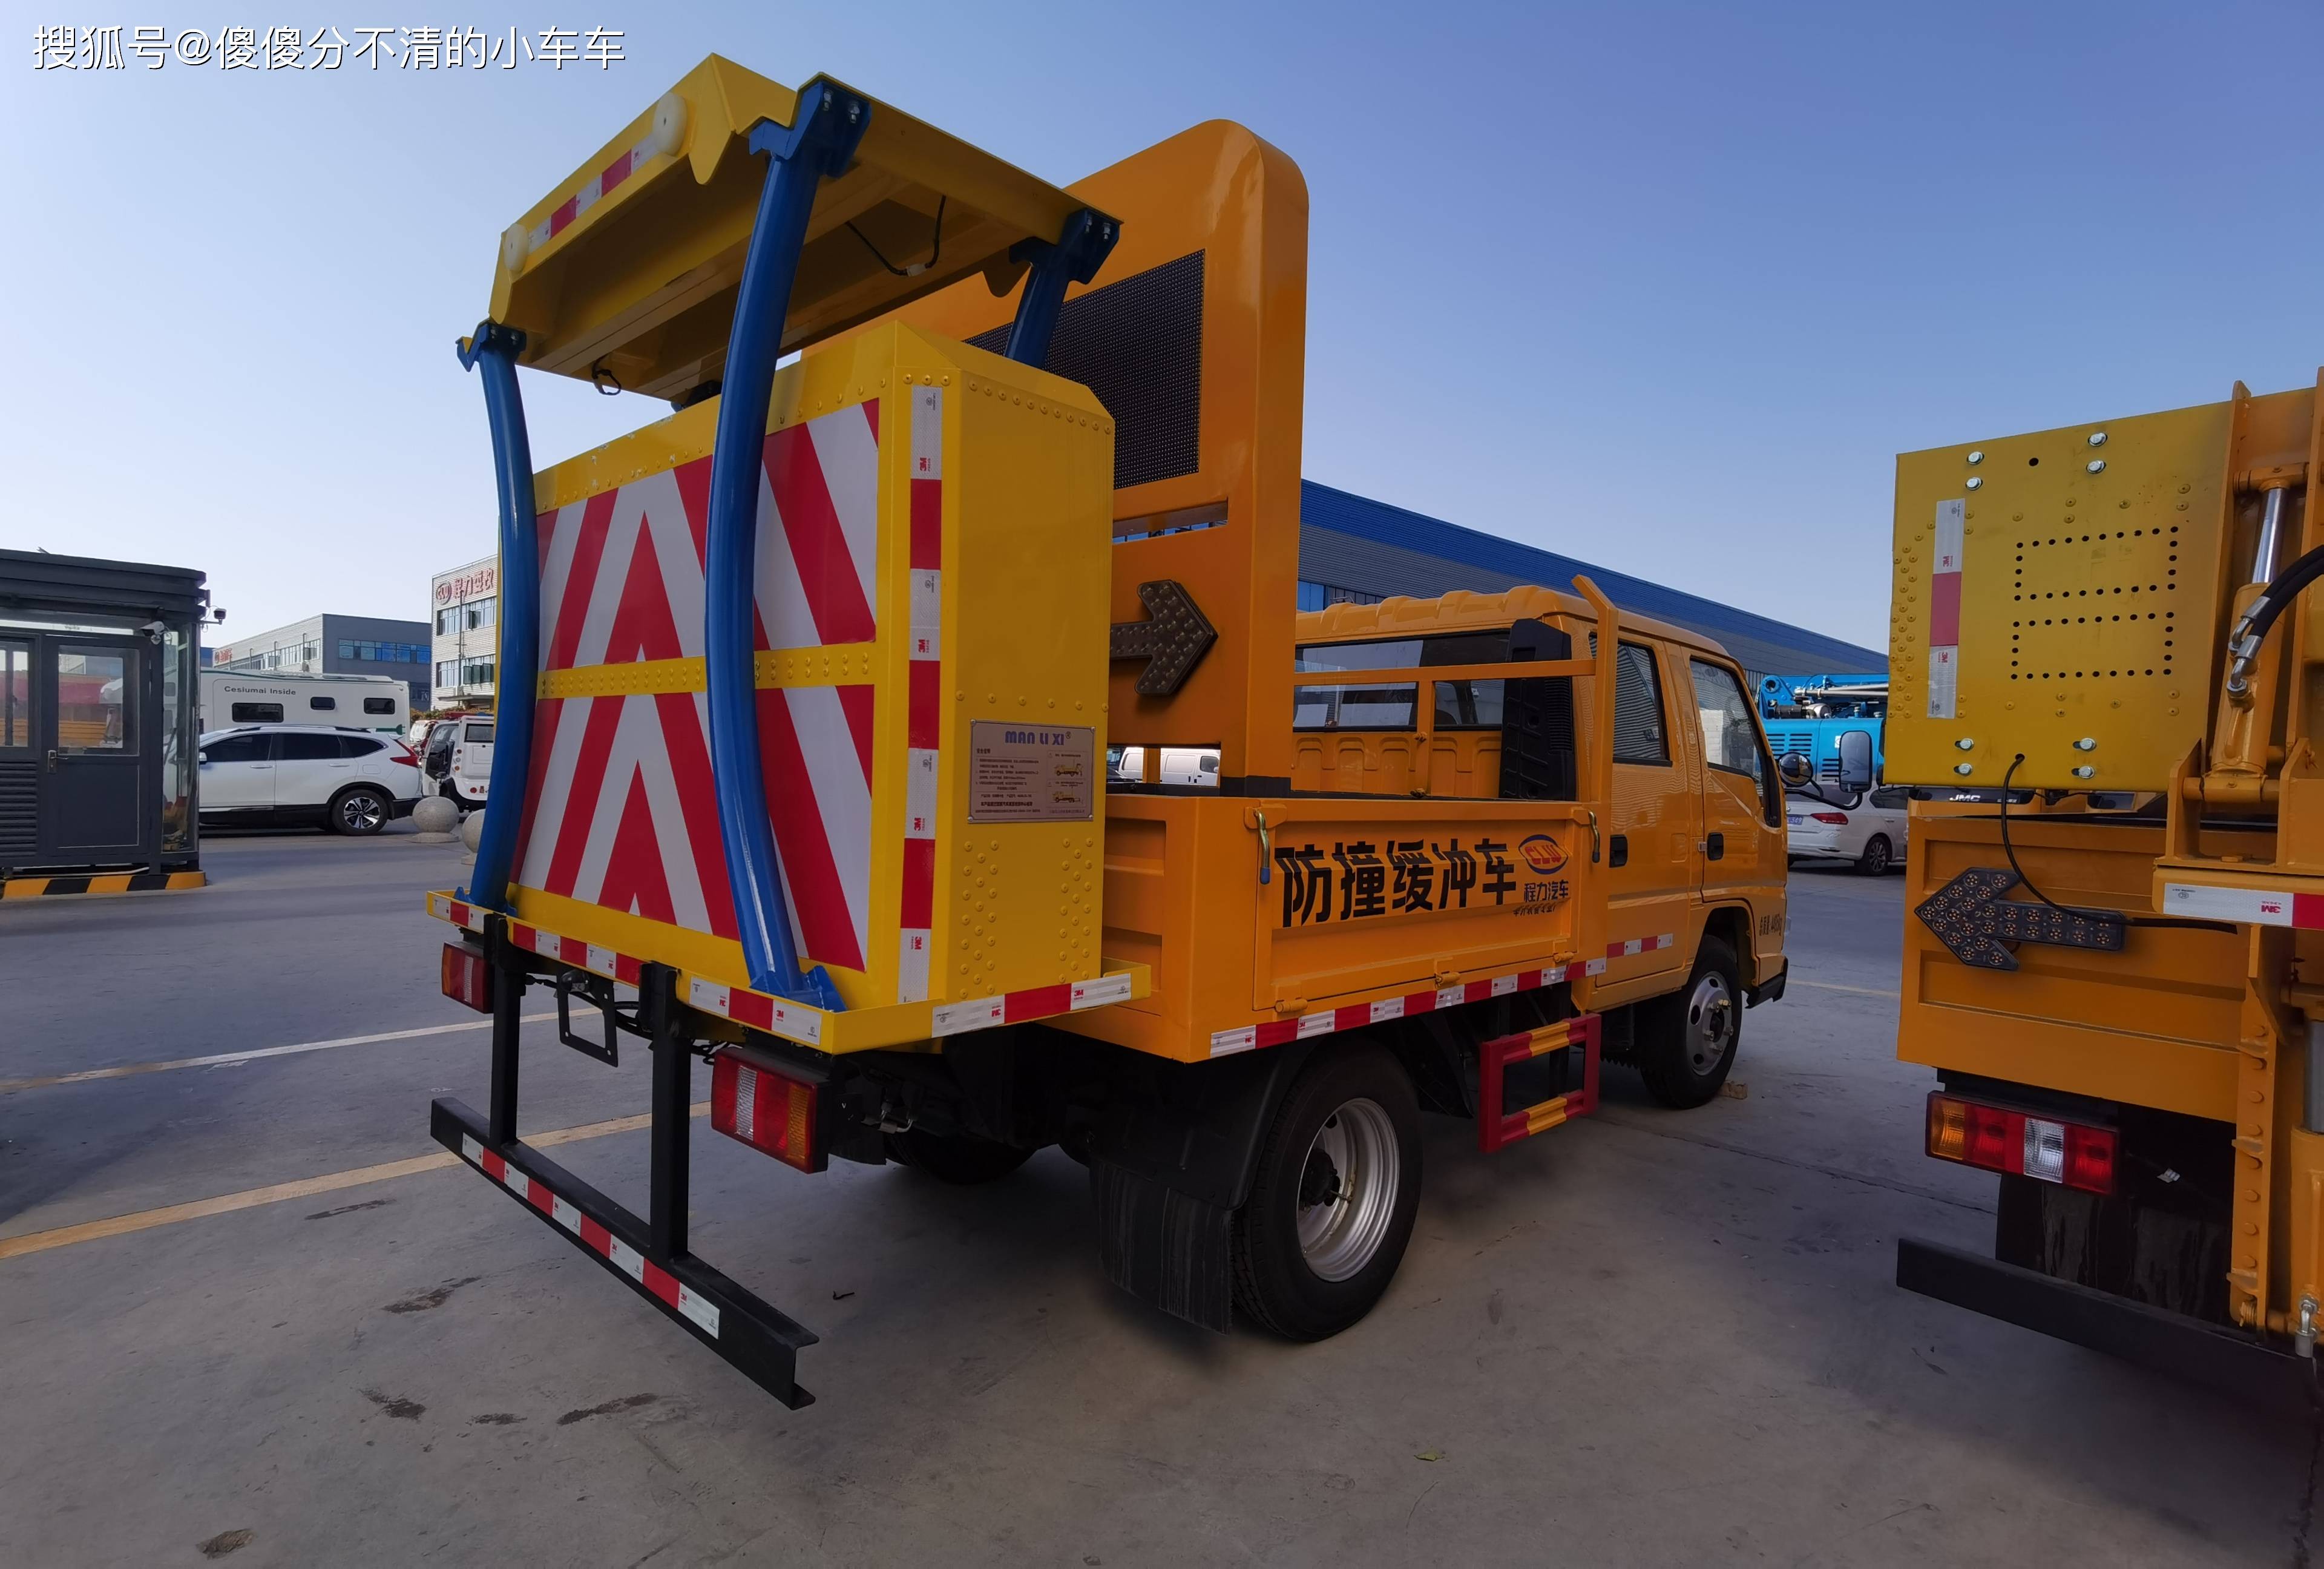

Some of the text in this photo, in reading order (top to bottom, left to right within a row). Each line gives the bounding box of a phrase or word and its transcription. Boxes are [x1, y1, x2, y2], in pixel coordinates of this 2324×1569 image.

[919, 457, 927, 472] 3M
[1943, 556, 1950, 567] 3M
[918, 639, 925, 653] 3M
[1941, 652, 1948, 663] 3M
[1005, 731, 1035, 745] MAN
[914, 817, 922, 831] 3M
[1274, 838, 1517, 928] 防撞缓冲车
[1523, 880, 1569, 903] 程力汽车
[2261, 905, 2281, 913] 3M
[914, 936, 922, 950] 3M
[776, 1010, 784, 1018] 3M
[991, 1008, 1001, 1018] 3M
